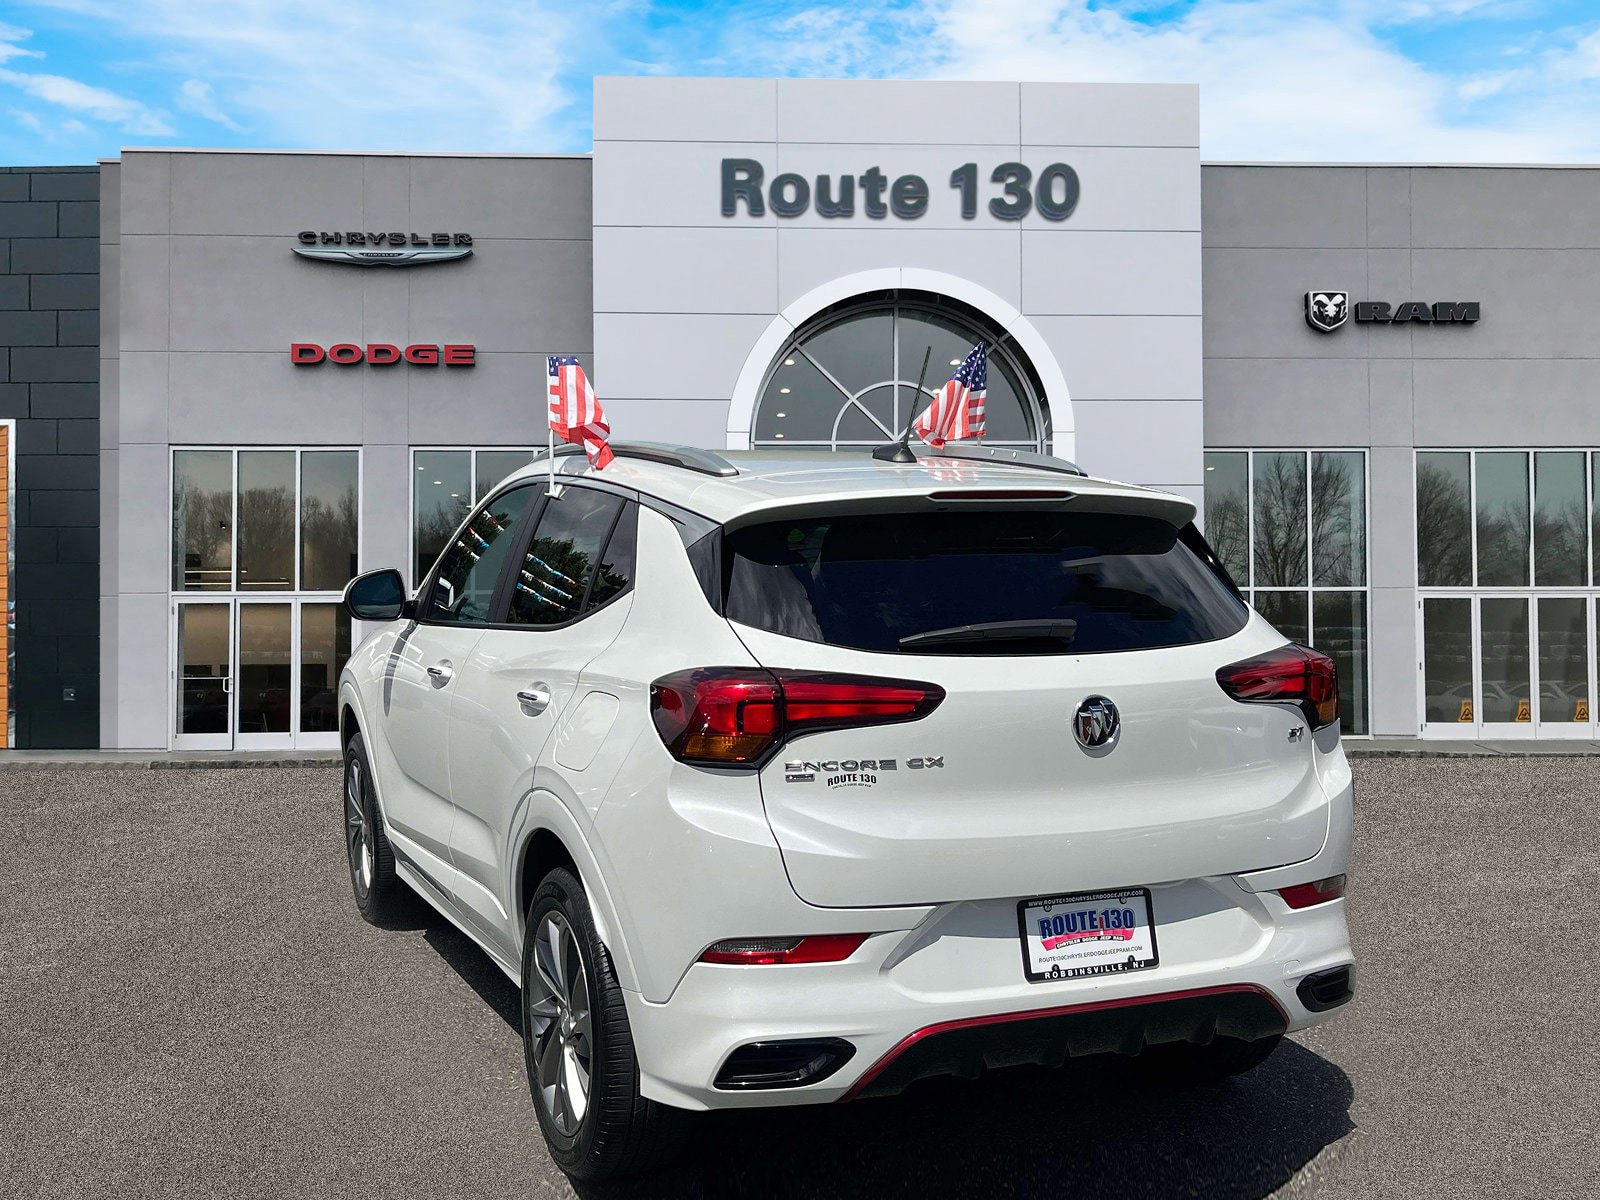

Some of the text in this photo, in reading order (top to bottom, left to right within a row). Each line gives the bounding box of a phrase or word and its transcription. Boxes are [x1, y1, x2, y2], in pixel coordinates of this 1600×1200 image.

[720, 157, 1081, 222] Route 130
[297, 231, 473, 246] CHRYSLER
[1355, 301, 1481, 323] RAM
[290, 343, 476, 365] DODGE
[784, 756, 945, 772] ENCORE GX
[827, 773, 858, 787] ROUTE
[859, 773, 877, 784] 130
[1028, 889, 1144, 907] WWW.ROUTE130CHRYSLERDODGEJEEP.COM
[1038, 908, 1135, 940] ROUTE 130
[1038, 945, 1143, 963] ROUTE130CHRYSLERDODGEJEEPRAM.COM
[1044, 960, 1145, 979] ROBBINSVILLE, NJ
